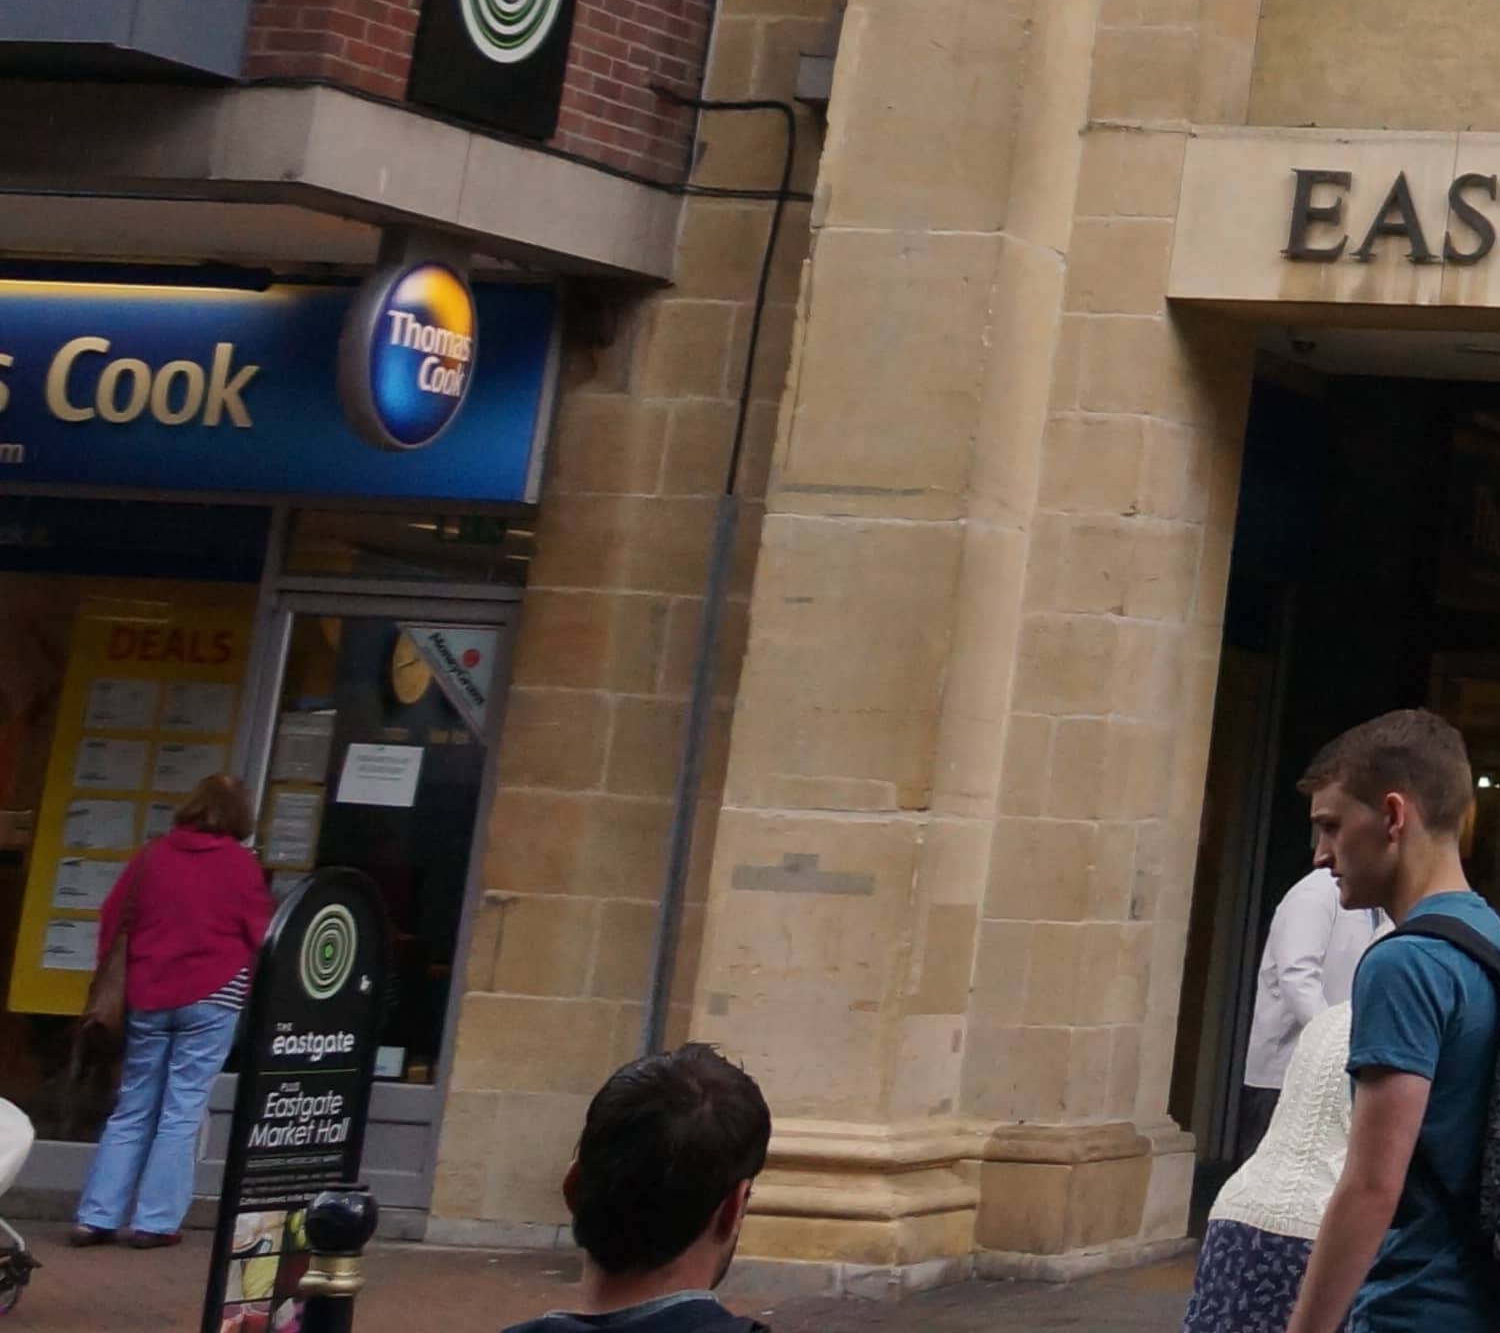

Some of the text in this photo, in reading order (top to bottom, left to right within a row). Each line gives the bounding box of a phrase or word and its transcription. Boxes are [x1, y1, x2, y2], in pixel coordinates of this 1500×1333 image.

[388, 309, 472, 361] Thomas
[45, 336, 261, 429] Cook
[418, 355, 465, 398] Cook
[107, 626, 232, 665] DEALS
[428, 633, 486, 707] MoneyGram
[276, 1022, 294, 1031] THE
[271, 1031, 355, 1062] eastgate
[264, 1090, 344, 1123] Eastgate
[248, 1117, 351, 1148] Market Hall
